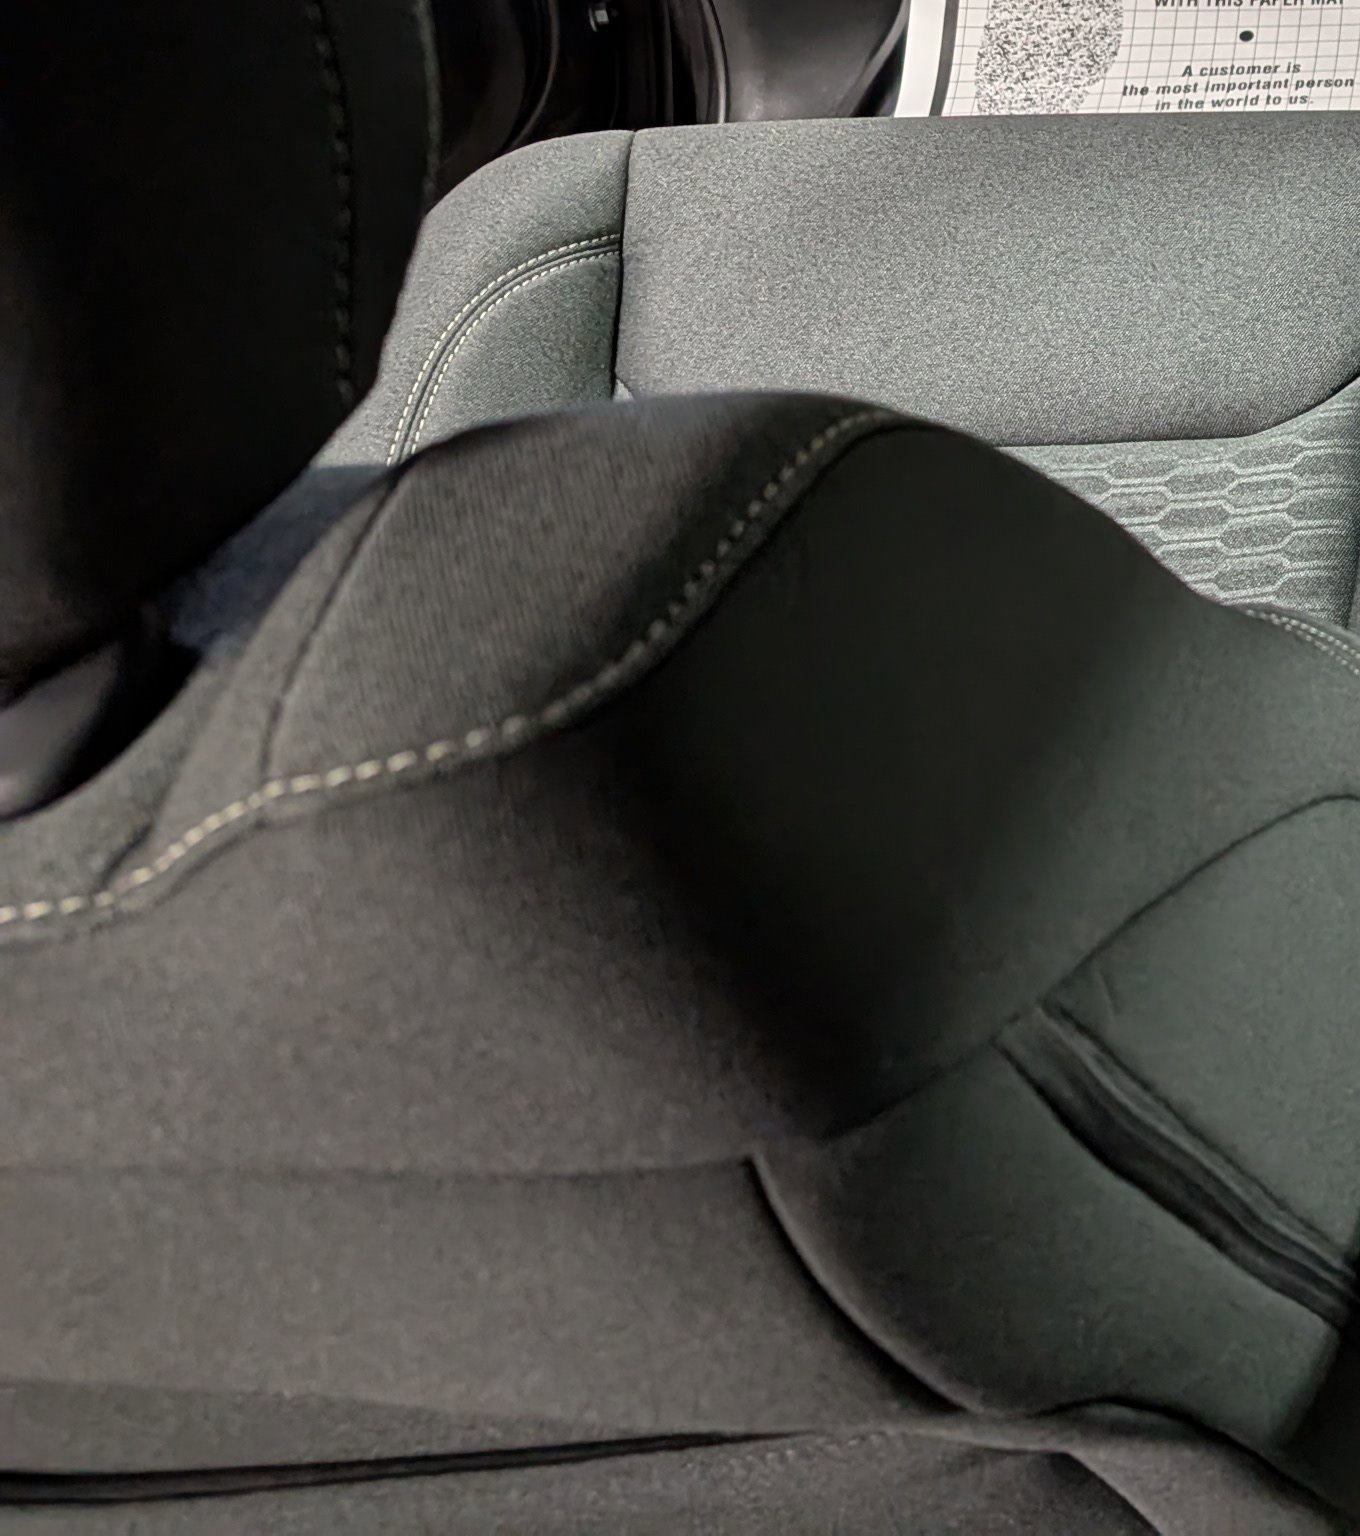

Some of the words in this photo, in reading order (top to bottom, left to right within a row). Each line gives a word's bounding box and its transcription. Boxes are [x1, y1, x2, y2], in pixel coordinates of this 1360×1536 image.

[1181, 65, 1193, 77] A
[1200, 63, 1280, 77] customer
[1286, 61, 1301, 74] is
[1122, 84, 1149, 96] the
[1156, 81, 1198, 95] most
[1205, 78, 1289, 95] important
[1295, 77, 1355, 92] person
[1155, 99, 1171, 111] in
[1178, 97, 1205, 110] the
[1211, 94, 1259, 108] world
[1266, 94, 1282, 106] to
[1288, 93, 1314, 105] us.
